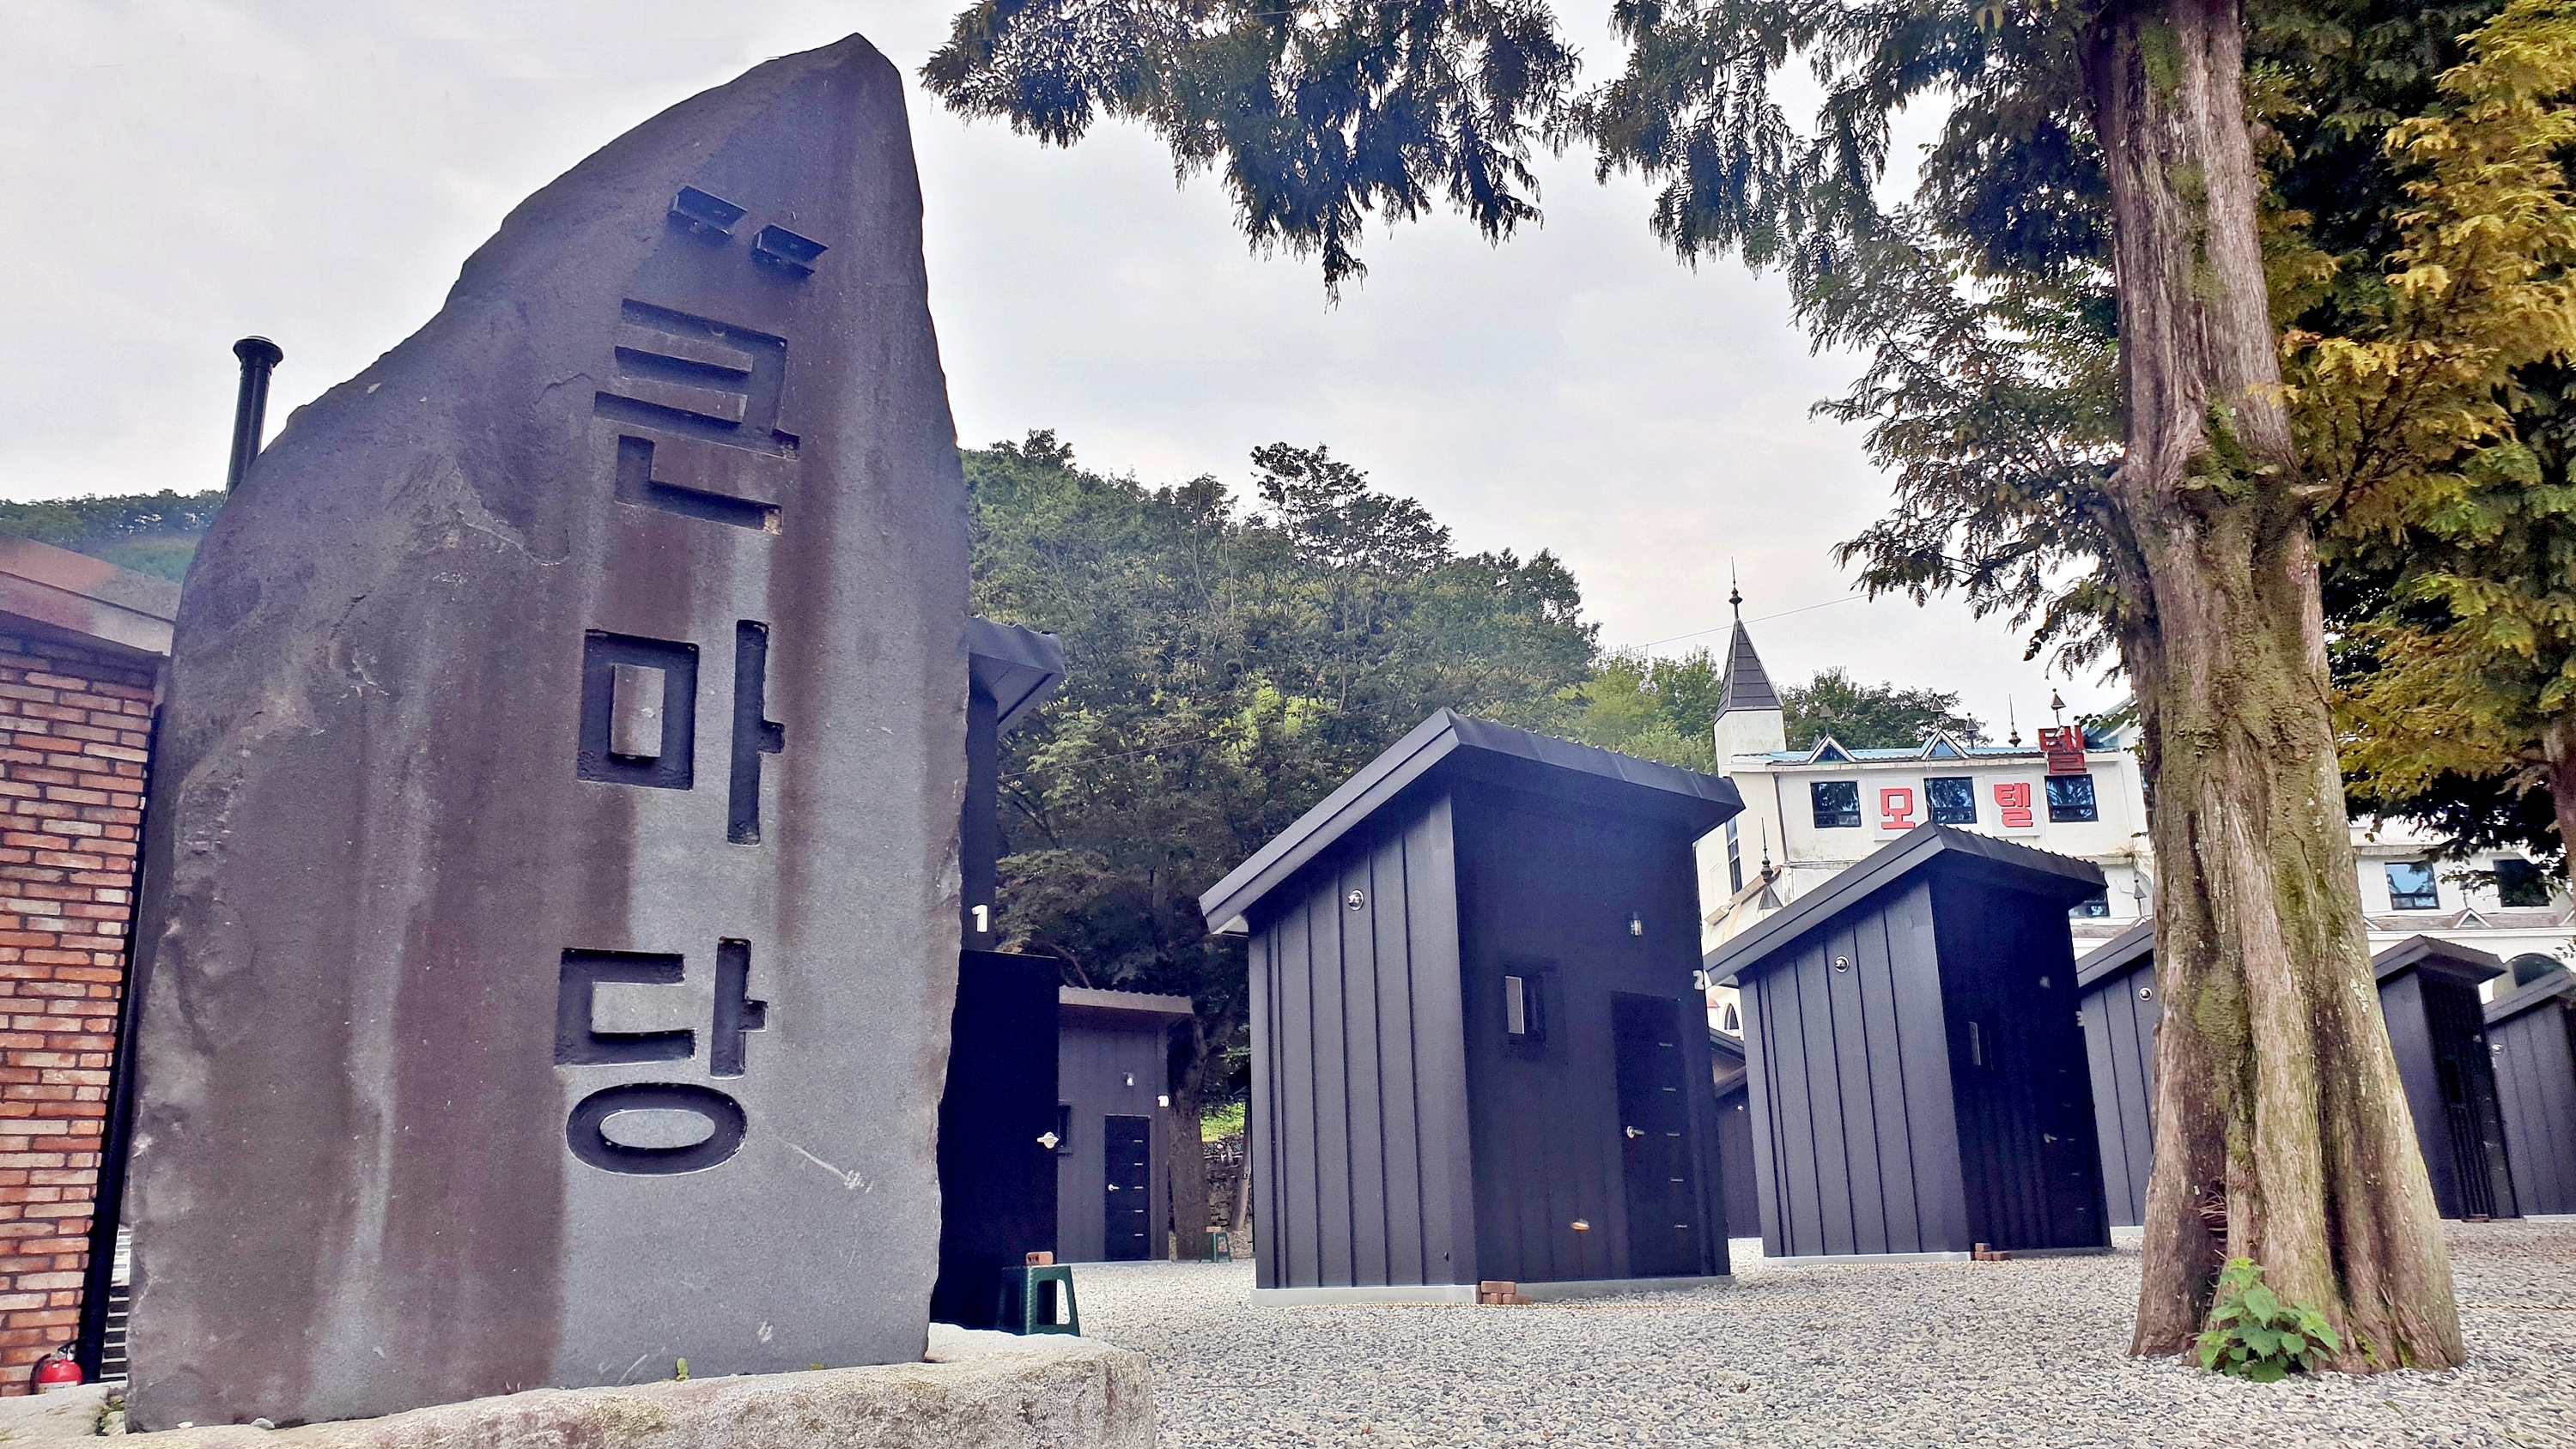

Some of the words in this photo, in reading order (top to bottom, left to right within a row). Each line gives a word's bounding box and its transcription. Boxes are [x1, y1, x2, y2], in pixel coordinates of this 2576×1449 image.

[554, 297, 800, 1176] 큰마당
[2038, 725, 2087, 774] 텔
[1880, 782, 2033, 829] 모텔
[971, 904, 987, 932] 1
[1692, 969, 1704, 990] 2
[1157, 1094, 1169, 1107] 10
